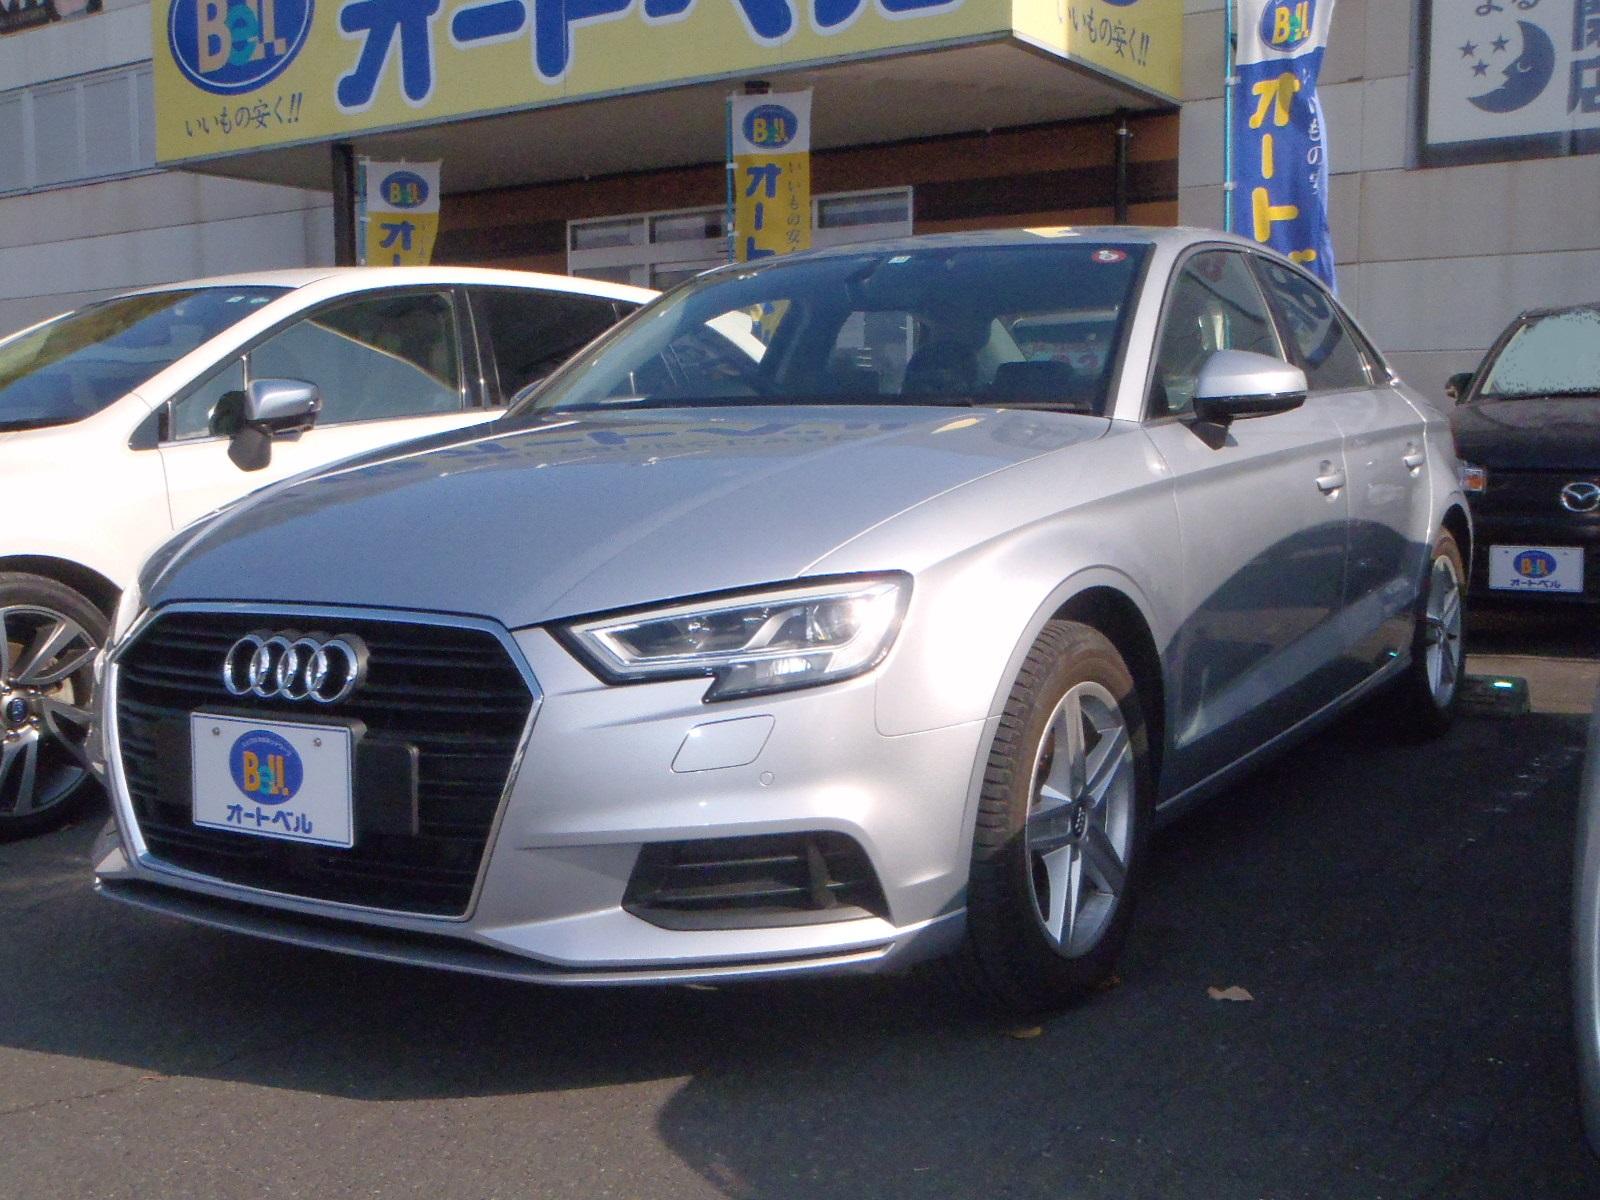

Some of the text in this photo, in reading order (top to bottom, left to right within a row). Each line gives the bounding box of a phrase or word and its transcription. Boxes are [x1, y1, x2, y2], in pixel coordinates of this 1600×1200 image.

[184, 92, 303, 137] いいもの安く!!
[226, 803, 313, 835] オートベル
